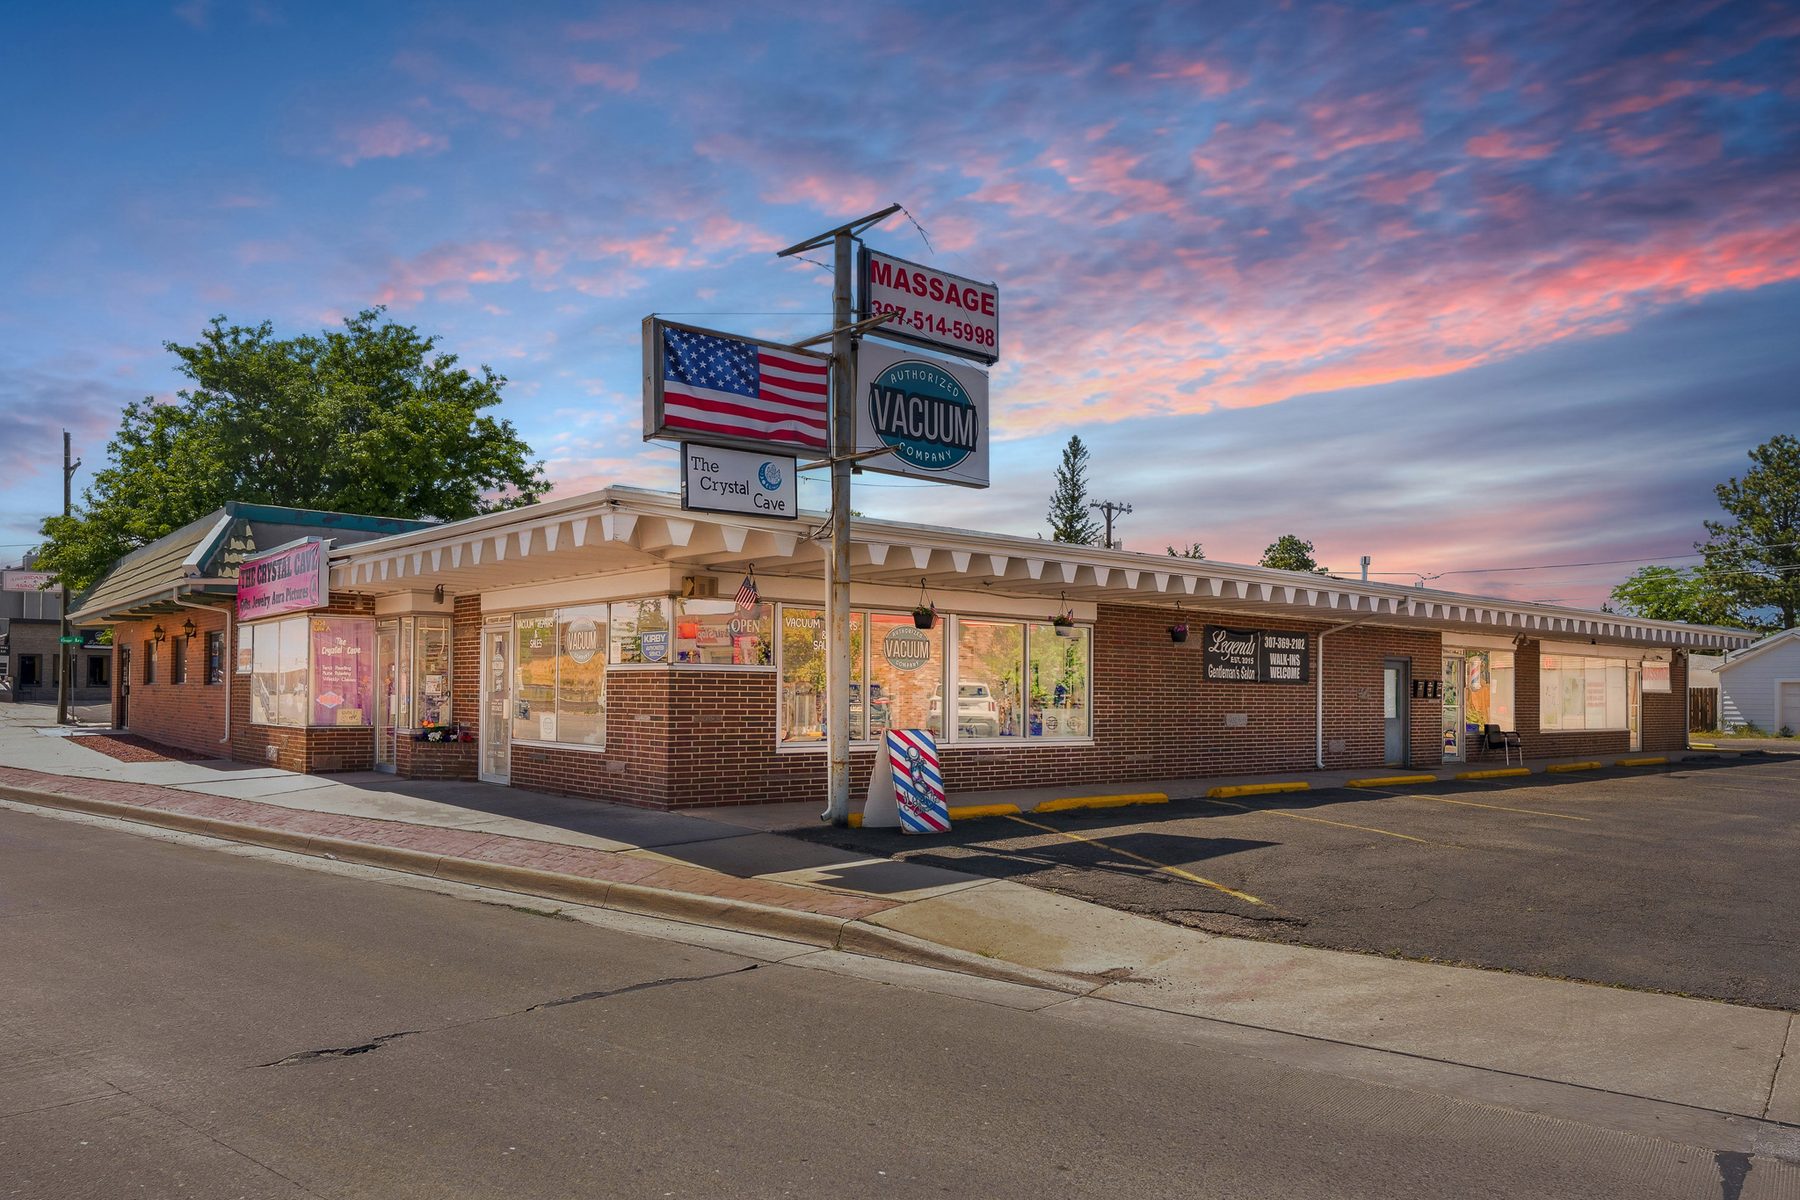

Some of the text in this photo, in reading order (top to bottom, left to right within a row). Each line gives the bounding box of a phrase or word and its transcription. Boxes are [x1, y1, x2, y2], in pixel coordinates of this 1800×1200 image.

[872, 260, 994, 316] MASSAGE
[891, 370, 959, 397] AUTHORIZED
[874, 389, 973, 447] VACUUM
[899, 442, 952, 462] COMPANY
[691, 456, 719, 473] The
[700, 476, 750, 495] Crystal
[753, 493, 785, 511] Cave
[241, 566, 256, 589] THE
[257, 556, 292, 585] CRYSTAL
[252, 594, 271, 609] Jewelry
[272, 592, 285, 605] Aura
[286, 587, 309, 602] Pictures
[731, 618, 760, 633] OPEN
[785, 617, 820, 629] VACUUM
[568, 630, 597, 651] VACUUM
[643, 633, 666, 643] KIRBY
[813, 640, 826, 650] SAL
[1208, 630, 1256, 661] Legends
[1264, 636, 1305, 650] 307-369-2102
[885, 640, 929, 659] VACUUM
[895, 660, 919, 668] COMPANY
[1270, 653, 1301, 666] WALK-INS
[1208, 664, 1255, 680] Gentleman's Salon
[1270, 666, 1300, 679] WELCOME
